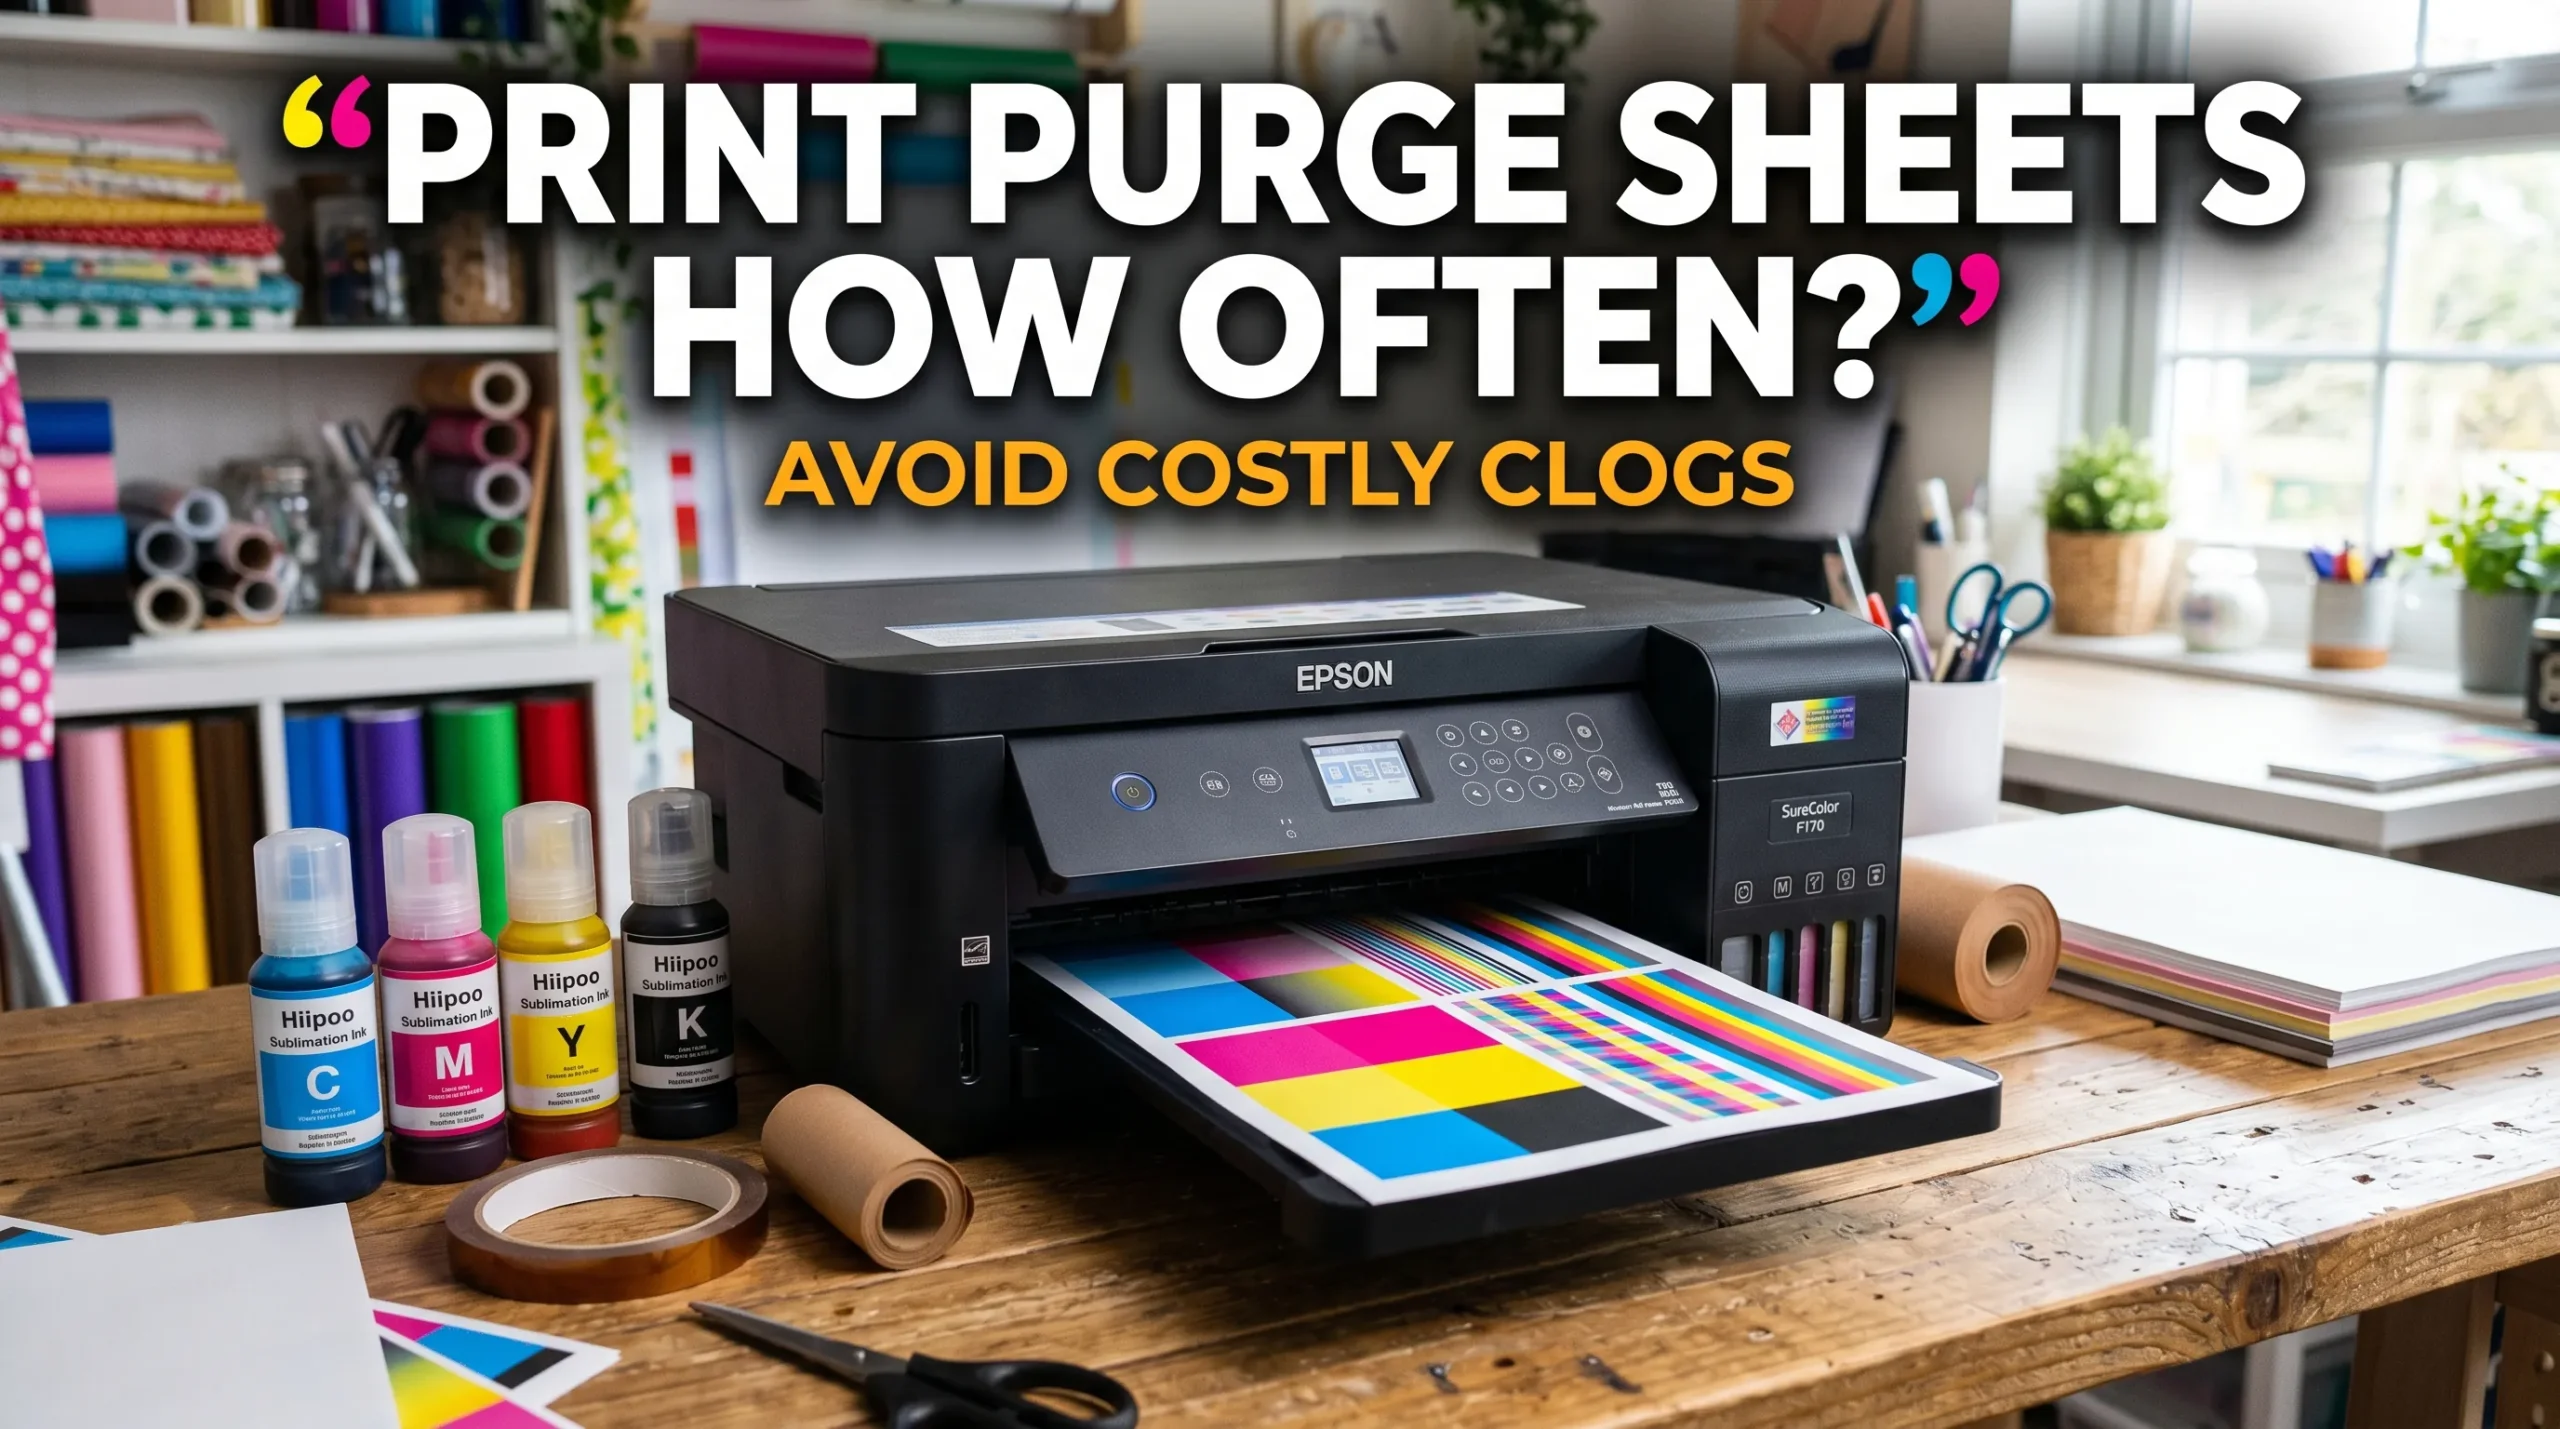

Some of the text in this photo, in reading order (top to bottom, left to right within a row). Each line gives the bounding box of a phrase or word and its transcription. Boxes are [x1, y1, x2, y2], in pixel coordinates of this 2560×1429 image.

[1297, 660, 1393, 692] EPSON
[1781, 800, 1840, 819] SureColor
[655, 954, 719, 976] Hiipoo
[533, 971, 600, 993] Hiipoo
[642, 978, 714, 991] Sublimation
[413, 988, 483, 1011] Hiipoo
[520, 988, 610, 1009] Sublimation Ink
[281, 1008, 354, 1031] Hiipoo
[401, 1006, 493, 1028] Sublimation Ink
[678, 1005, 708, 1041] K
[270, 1027, 367, 1049] Sublimation Ink
[557, 1024, 586, 1058] Y
[435, 1042, 474, 1080] M
[306, 1065, 341, 1101] C
